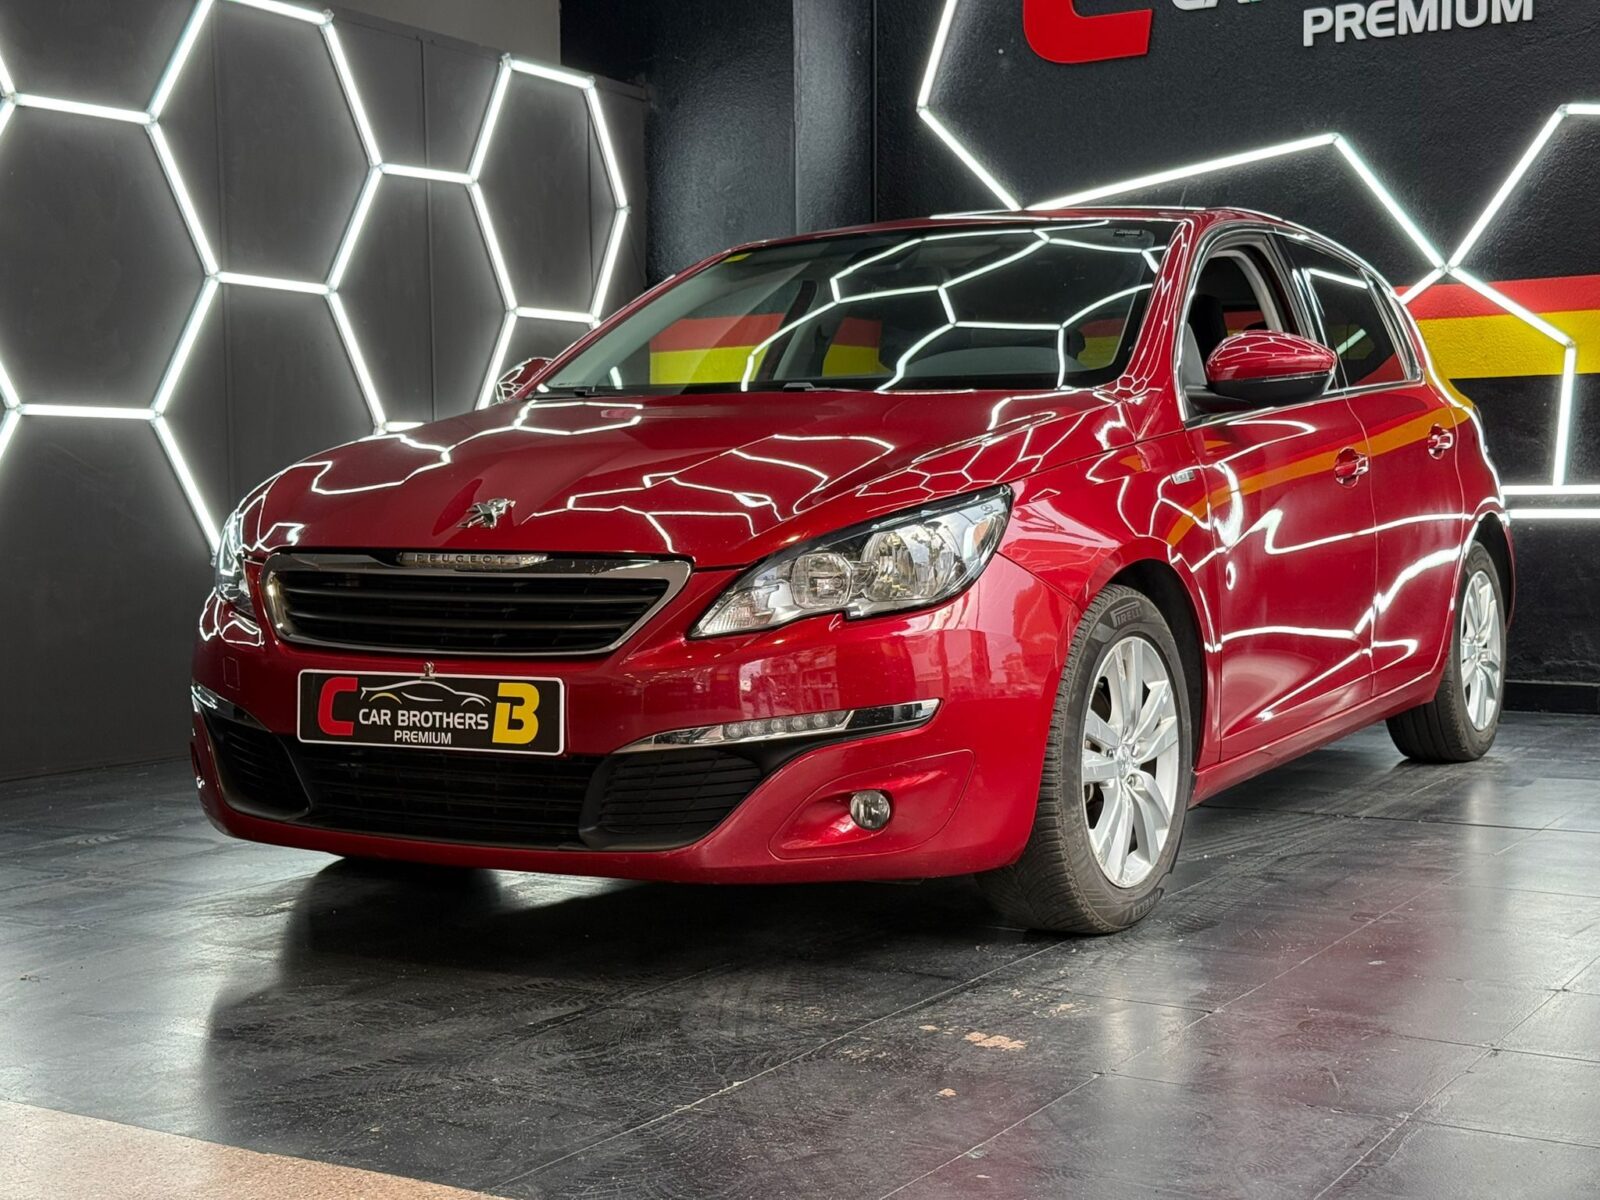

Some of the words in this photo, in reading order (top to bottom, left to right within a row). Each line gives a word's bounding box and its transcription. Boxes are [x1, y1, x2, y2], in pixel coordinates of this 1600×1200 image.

[1303, 0, 1533, 47] PREMIUM
[415, 553, 505, 564] PEUGEOT
[318, 677, 358, 736] C
[358, 708, 392, 726] CAR
[397, 710, 489, 730] BROTHERS
[394, 730, 452, 745] PREMIUM
